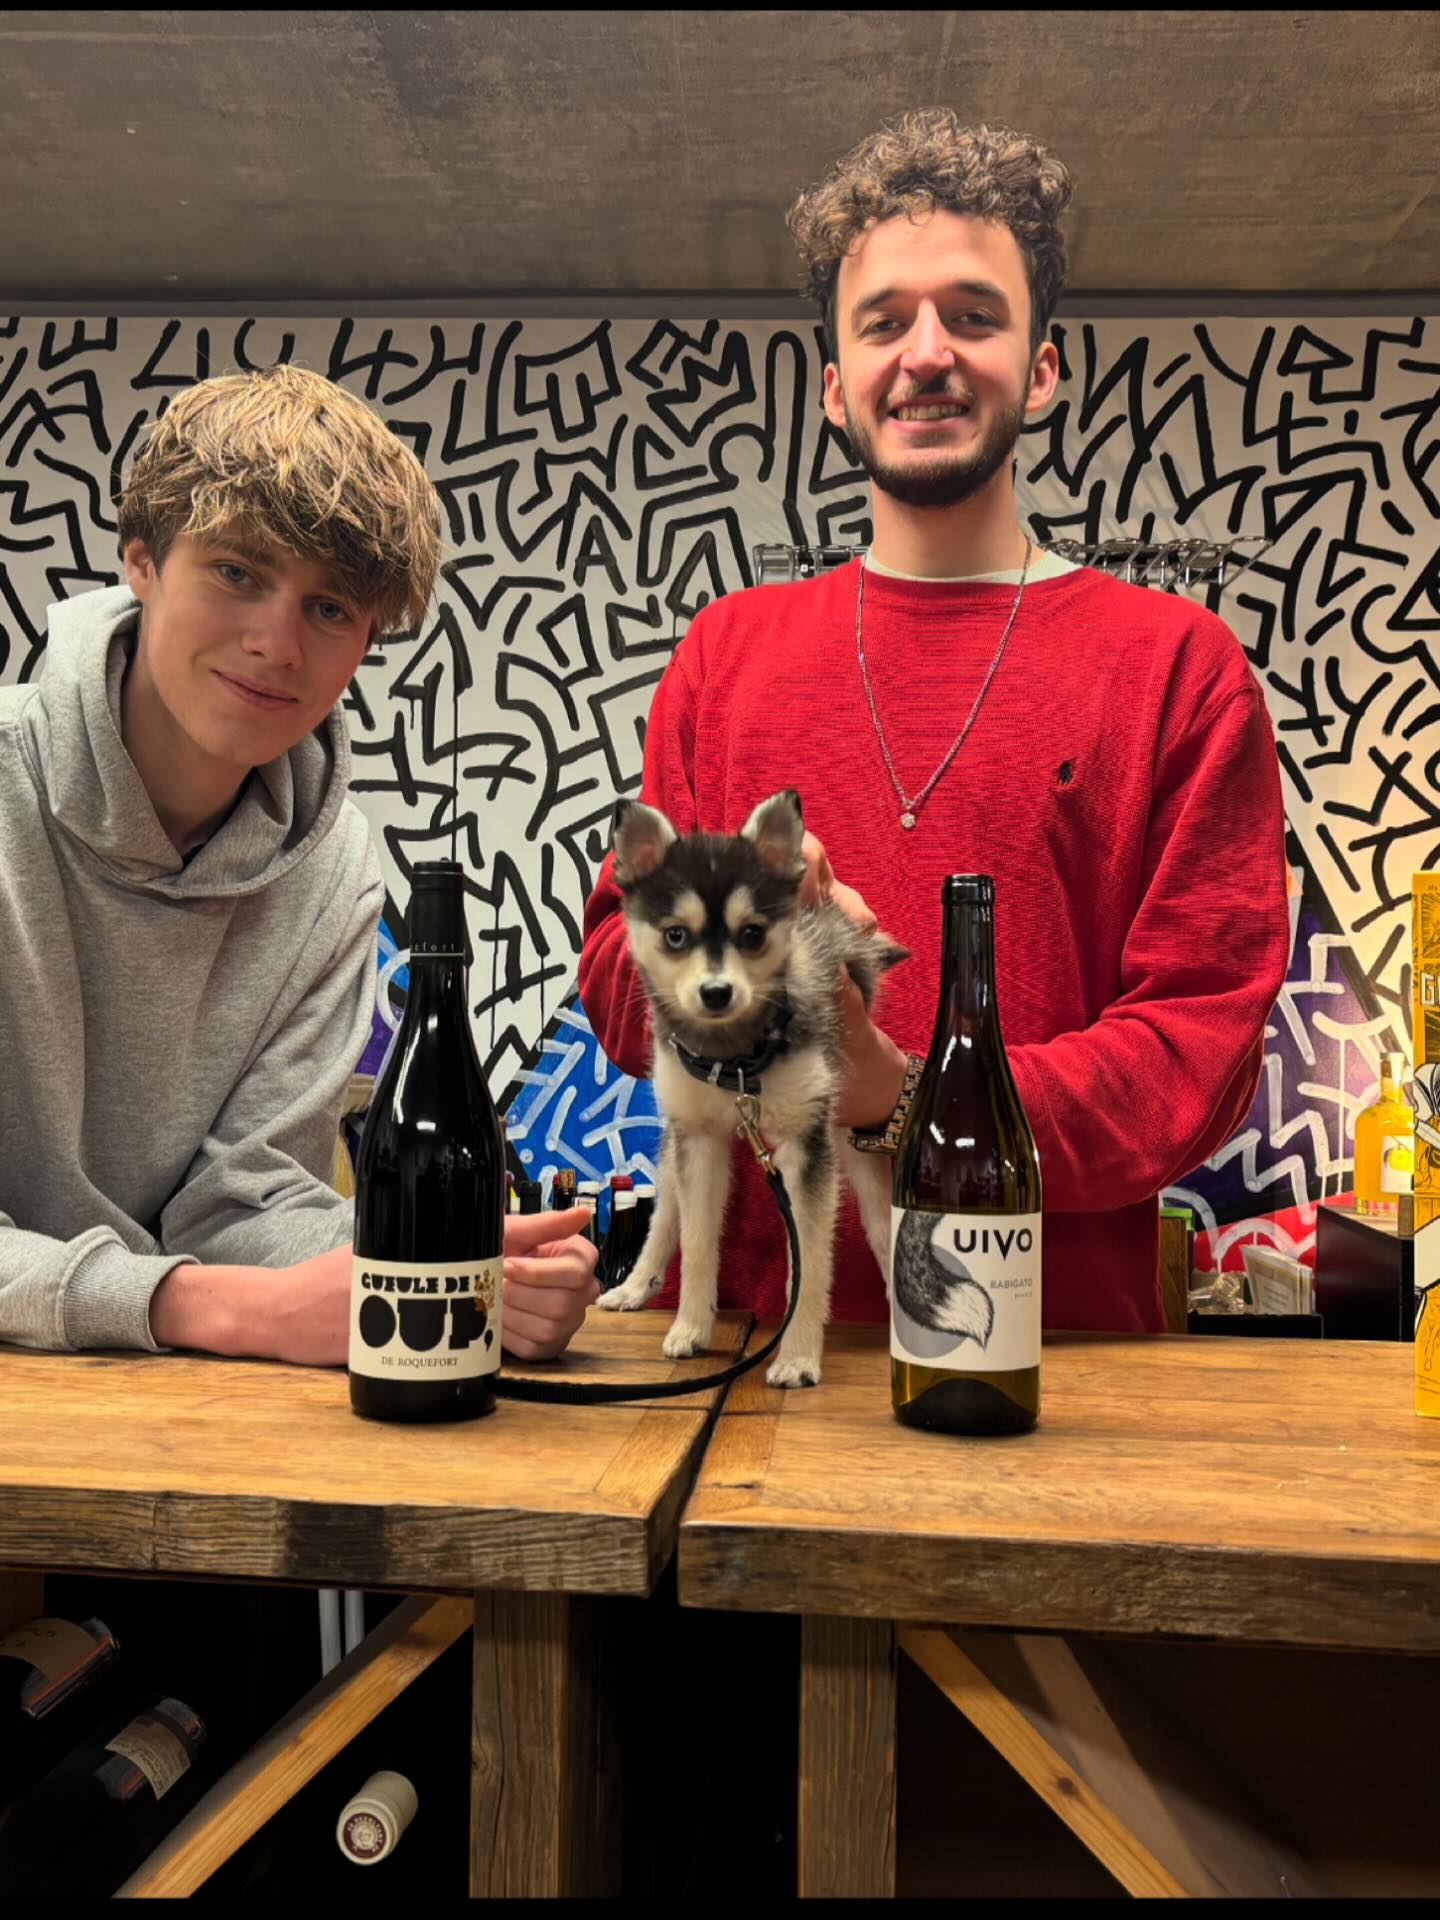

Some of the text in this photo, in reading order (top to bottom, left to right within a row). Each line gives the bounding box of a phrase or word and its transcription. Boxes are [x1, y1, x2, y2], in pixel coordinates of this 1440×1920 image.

[953, 1228, 1033, 1262] UIVO
[361, 1272, 439, 1294] GUEULE
[445, 1276, 469, 1293] DE
[990, 1278, 1033, 1289] RABIGATO
[381, 1356, 458, 1367] DE ROQUEFORT
